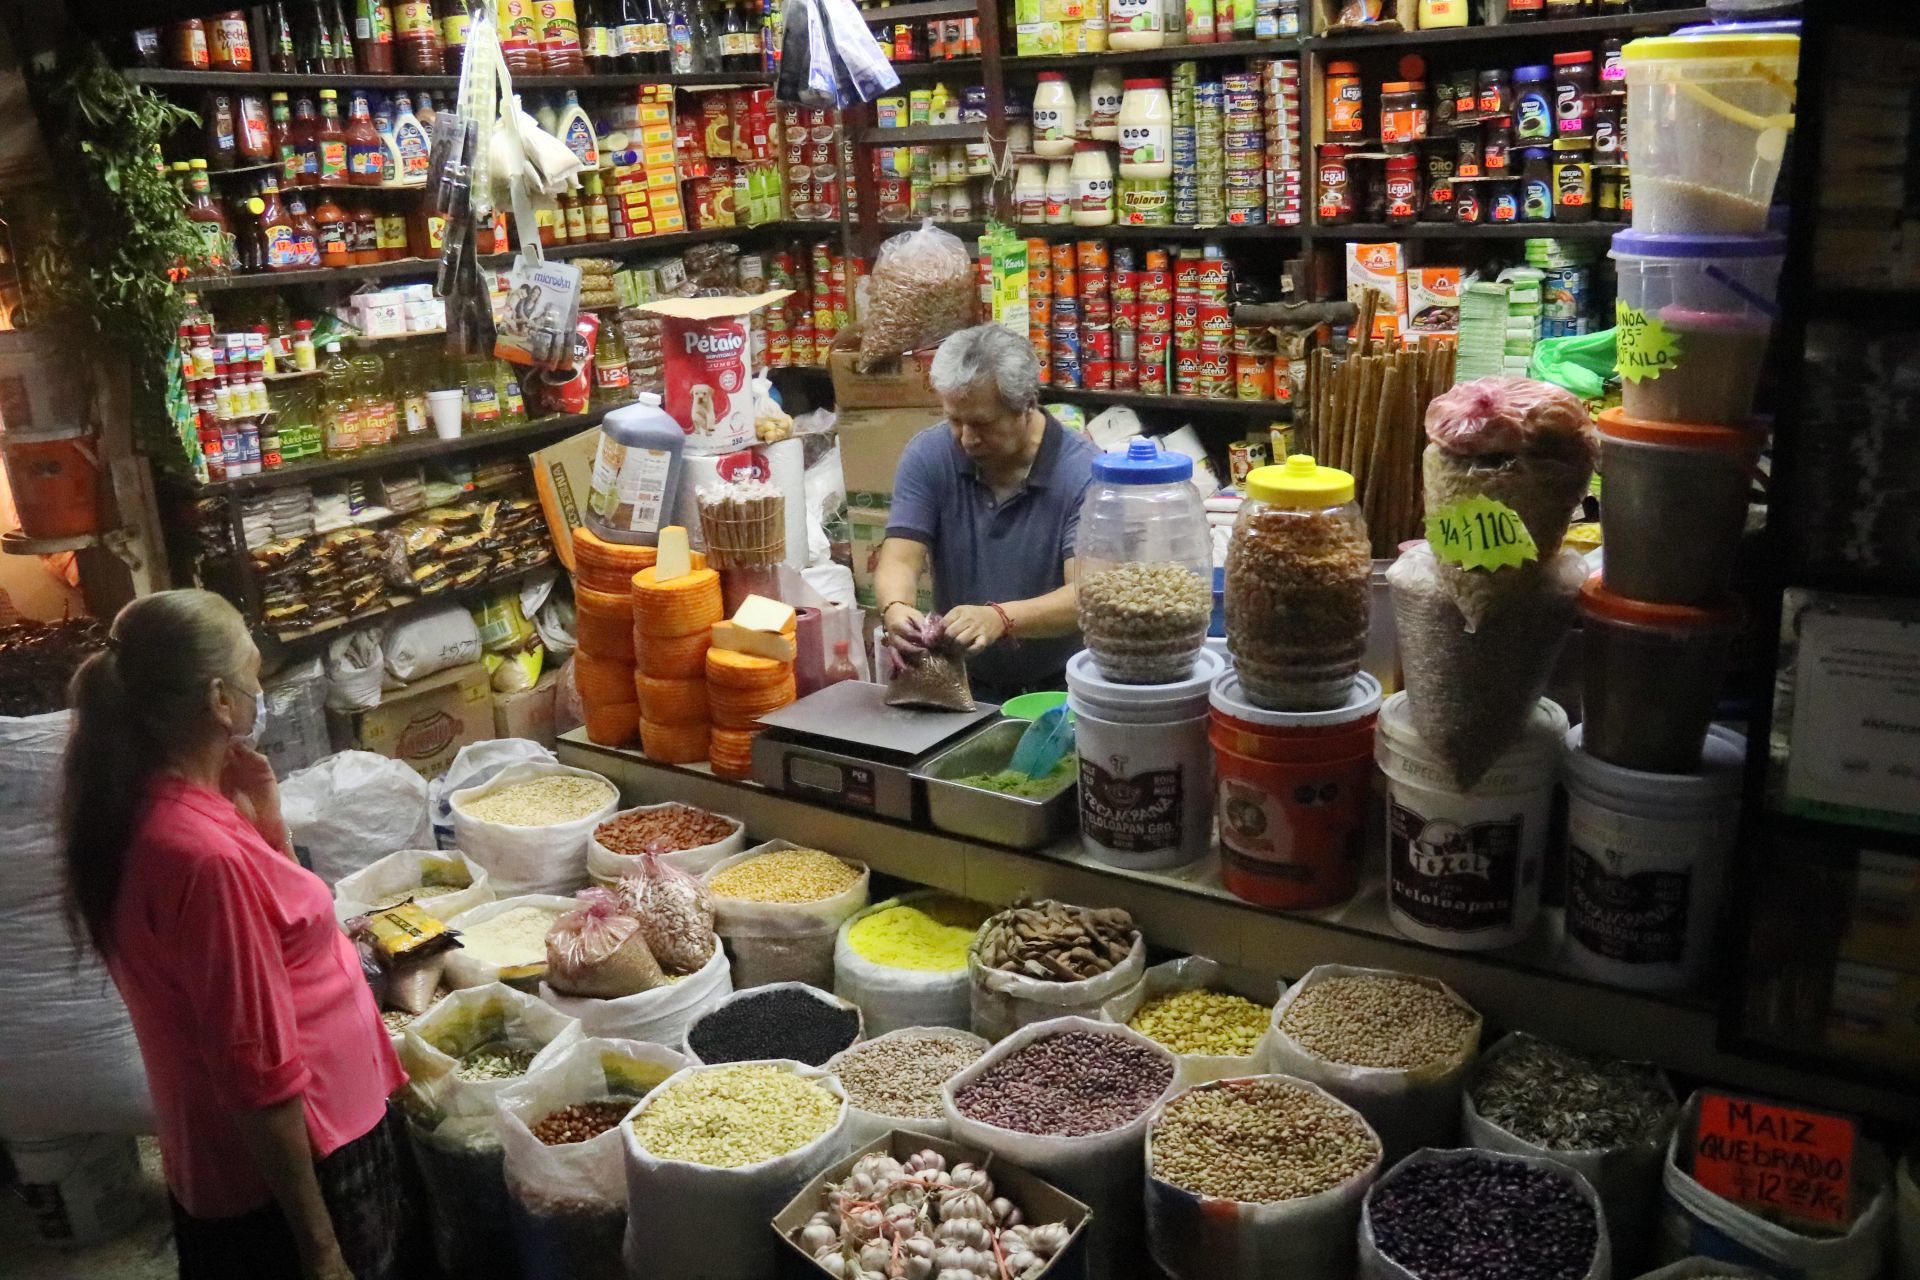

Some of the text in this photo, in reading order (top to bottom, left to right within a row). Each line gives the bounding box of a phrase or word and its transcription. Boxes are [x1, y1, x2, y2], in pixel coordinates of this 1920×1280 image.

[217, 29, 249, 41] RedHo
[1429, 161, 1453, 170] ORO
[1320, 170, 1346, 185] Legal
[1387, 183, 1412, 197] Legal
[1126, 191, 1166, 205] Dolores
[1005, 258, 1025, 269] Knorr
[534, 272, 571, 289] microdyn
[1179, 274, 1200, 282] Coste
[1618, 311, 1648, 328] INOA
[683, 331, 743, 353] Pétalo
[707, 360, 736, 369] JUMBO
[1629, 350, 1667, 367] KILO
[1728, 1102, 1817, 1146] MAIZ
[1699, 1133, 1843, 1181] QUEBRADO
